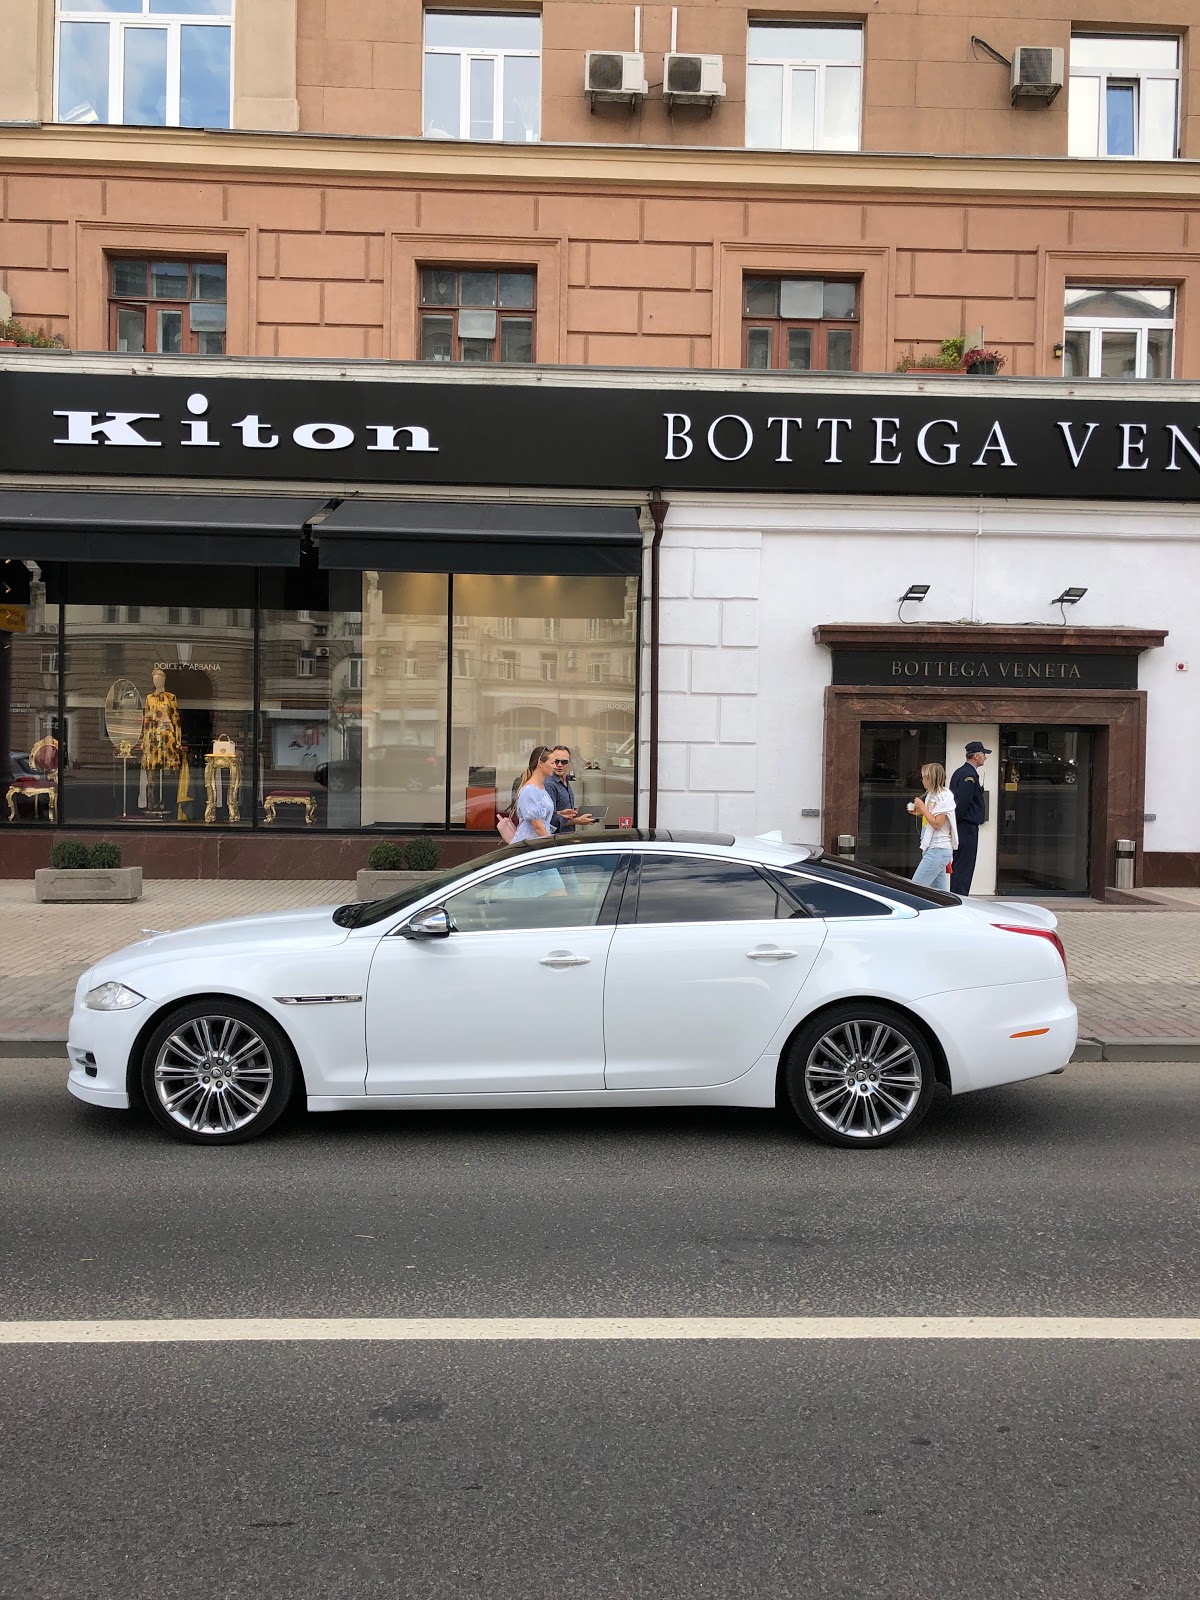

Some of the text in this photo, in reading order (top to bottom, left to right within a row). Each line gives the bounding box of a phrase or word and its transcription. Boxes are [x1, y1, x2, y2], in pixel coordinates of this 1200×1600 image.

[52, 393, 439, 452] Kiton
[662, 412, 1200, 471] BOTTEGA VEN
[153, 662, 178, 670] DOLCE
[892, 661, 1081, 678] BOTTEGA VENETA
